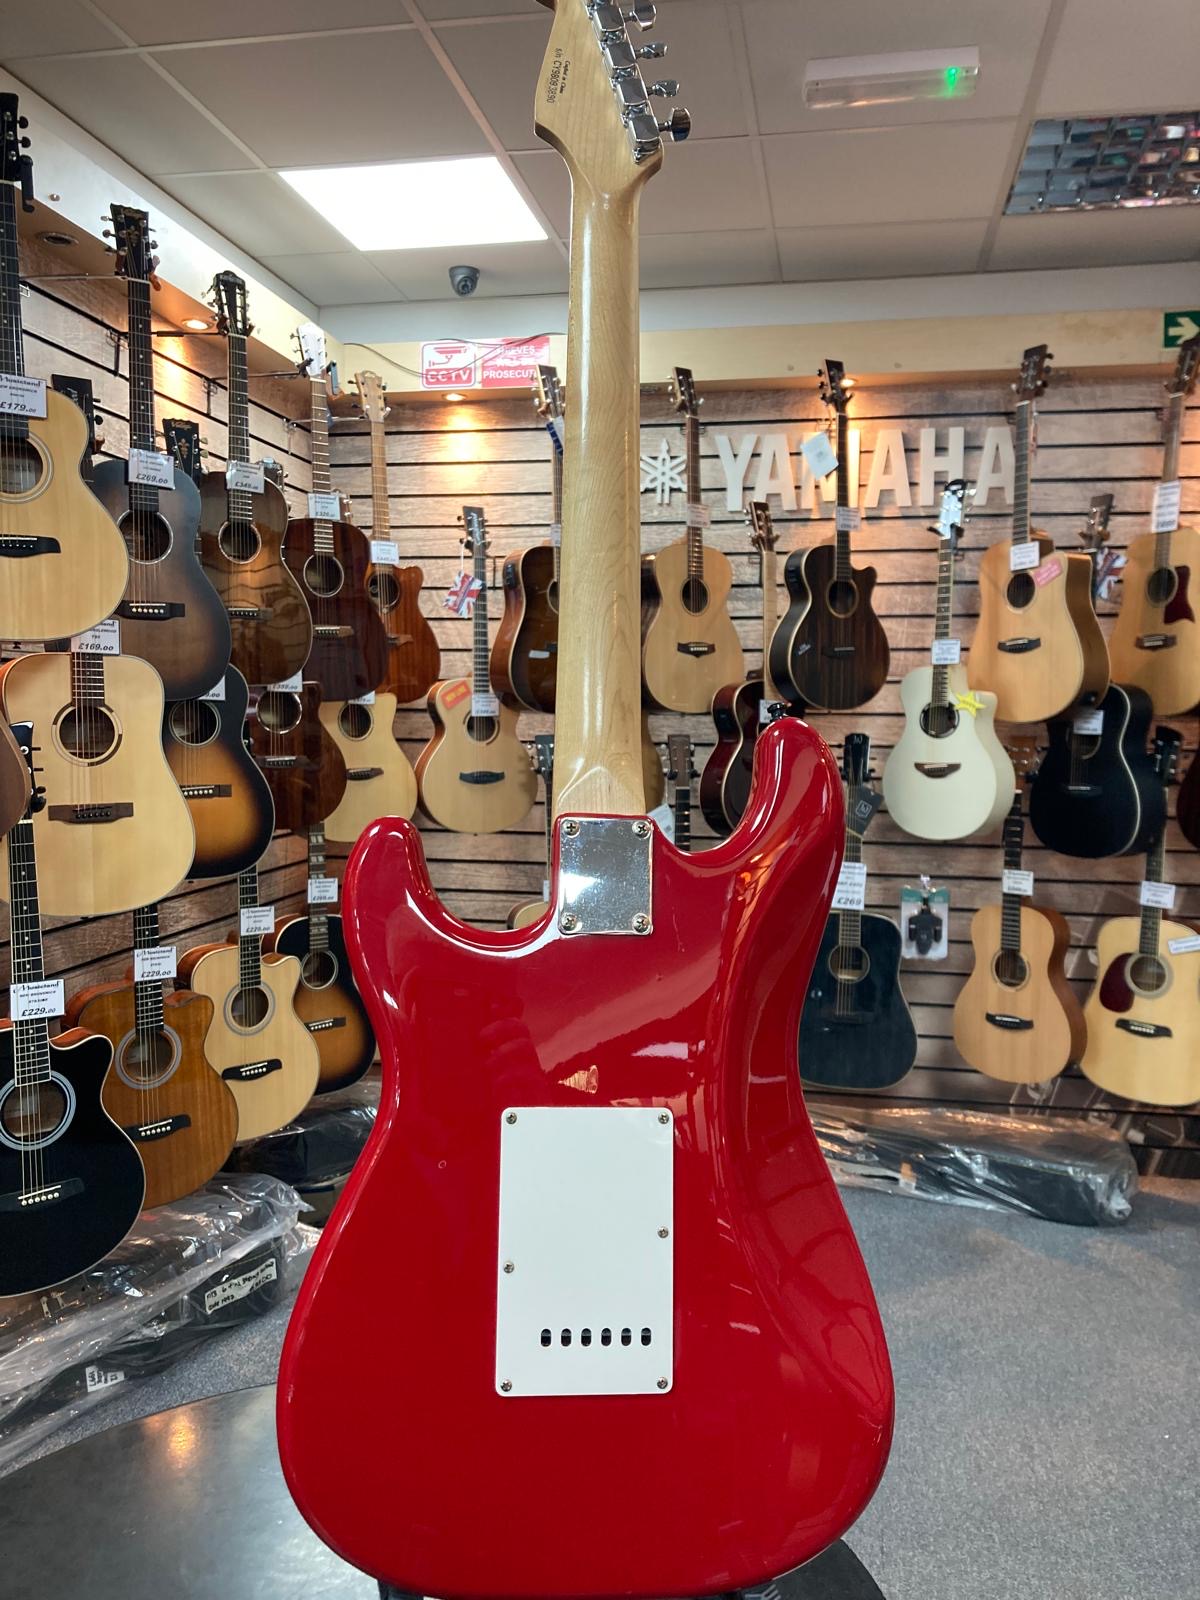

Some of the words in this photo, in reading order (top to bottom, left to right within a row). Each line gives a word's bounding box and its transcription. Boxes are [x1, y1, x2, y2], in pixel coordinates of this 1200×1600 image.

[427, 370, 470, 383] CCTV
[483, 368, 537, 379] PROSECUT
[78, 642, 114, 651] £169.00
[141, 970, 172, 978] £229.00
[21, 1006, 57, 1017] £229.00
